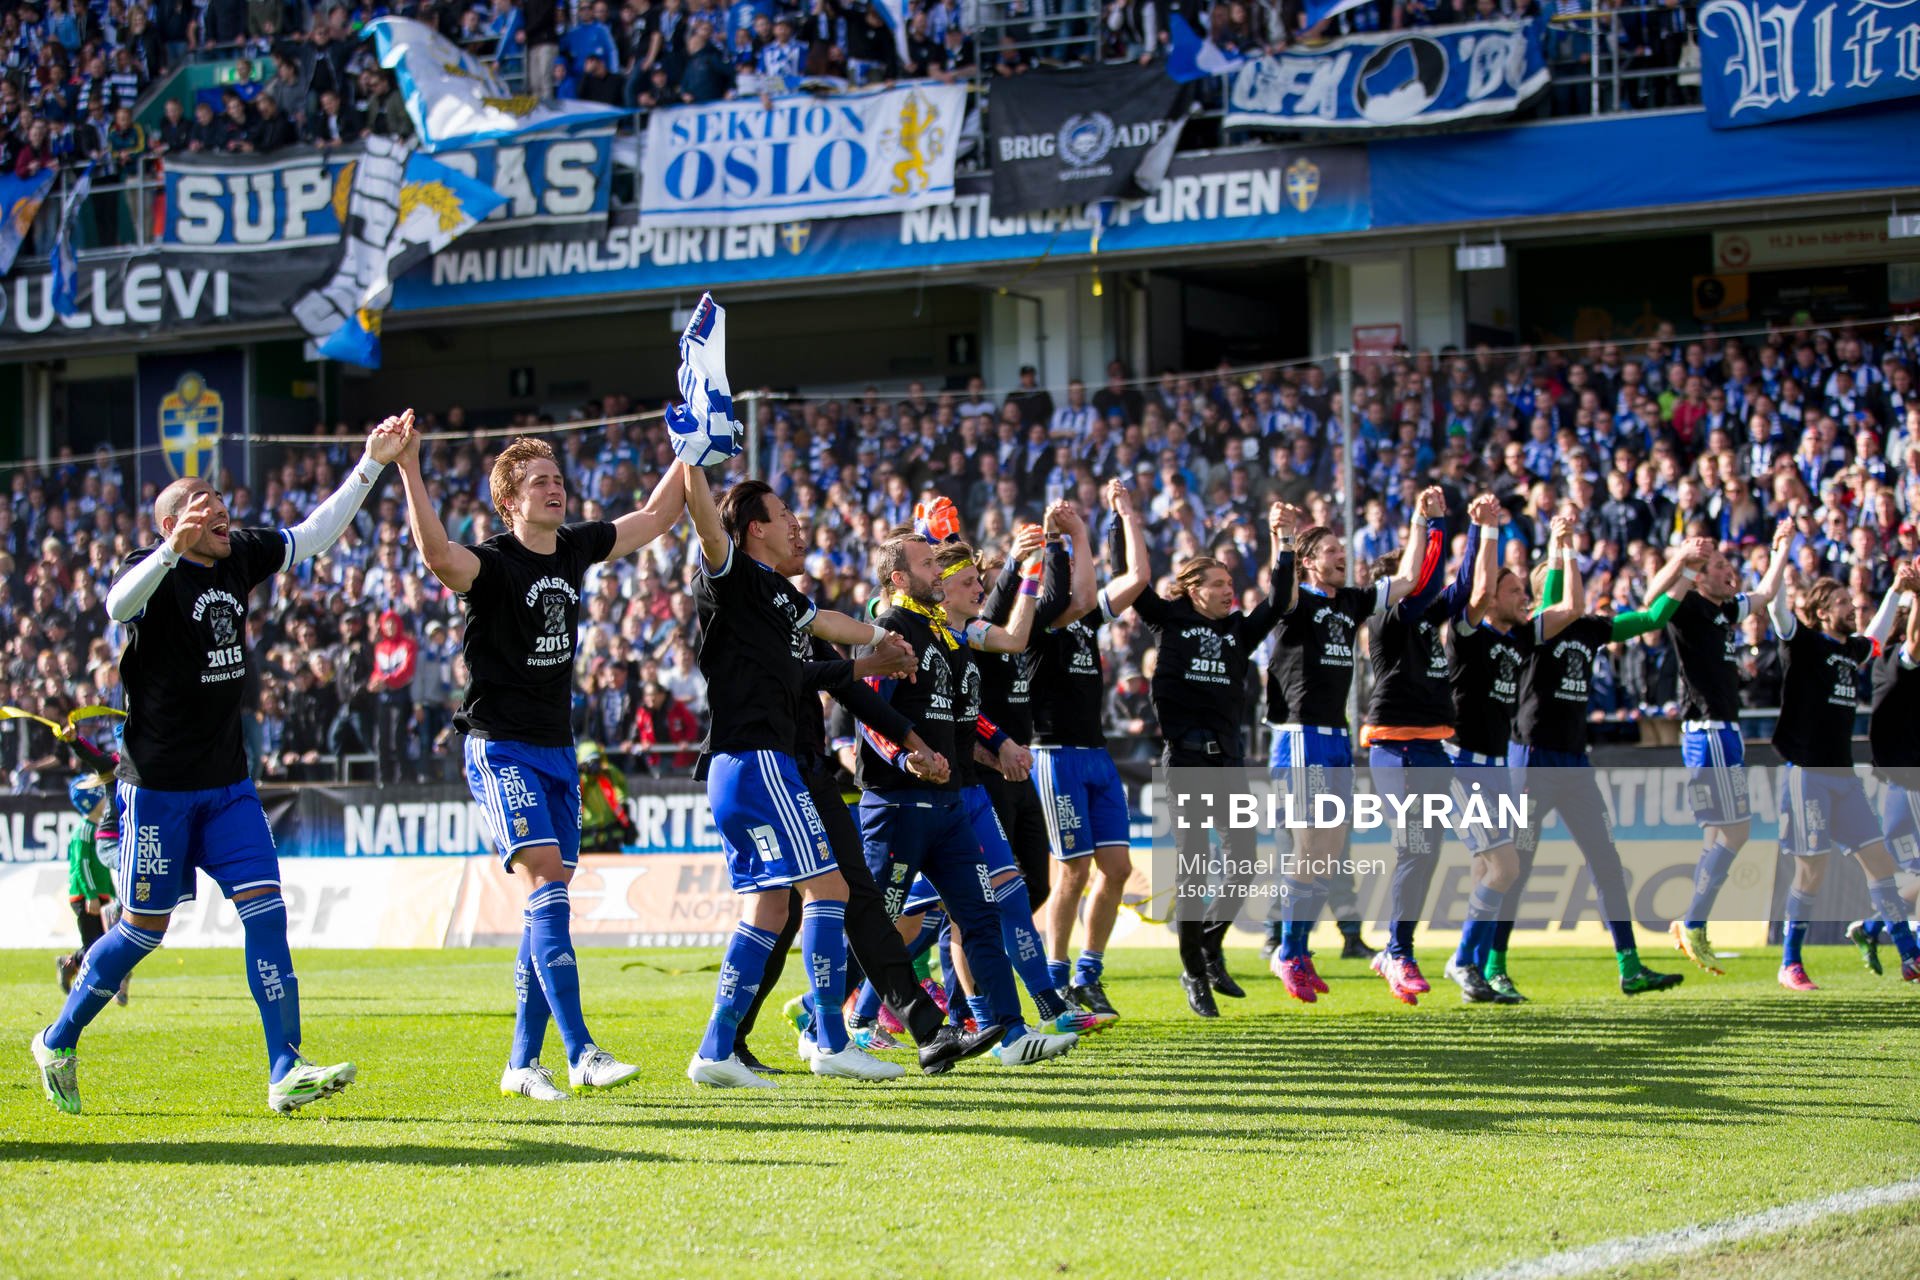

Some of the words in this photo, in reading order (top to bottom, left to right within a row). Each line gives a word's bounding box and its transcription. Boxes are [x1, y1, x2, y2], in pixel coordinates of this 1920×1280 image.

[671, 105, 865, 146] SEKTION
[999, 132, 1056, 162] BRIG
[665, 138, 868, 200] OSLO
[175, 165, 334, 245] SUP
[14, 264, 229, 333] ULEVI
[535, 633, 570, 653] 2015
[1325, 643, 1352, 656] 2015
[208, 645, 243, 668] 2015
[1191, 658, 1226, 673] 2015
[201, 672, 231, 683] SVENSKA
[1561, 678, 1587, 692] 2015
[499, 766, 521, 783] SE
[503, 779, 527, 796] RN
[508, 792, 537, 811] EKE
[1056, 794, 1072, 807] SE
[1057, 806, 1076, 818] RN
[1059, 816, 1083, 831] EKE
[138, 825, 160, 842] SE
[137, 842, 162, 858] RN
[1409, 842, 1432, 854] EKE
[136, 858, 169, 875] EKE
[884, 887, 904, 902] SE
[1014, 926, 1039, 962] SKF
[811, 952, 831, 988] SKF
[256, 958, 286, 1003] SKF
[515, 959, 531, 1003] SKF
[720, 961, 741, 999] SKF
